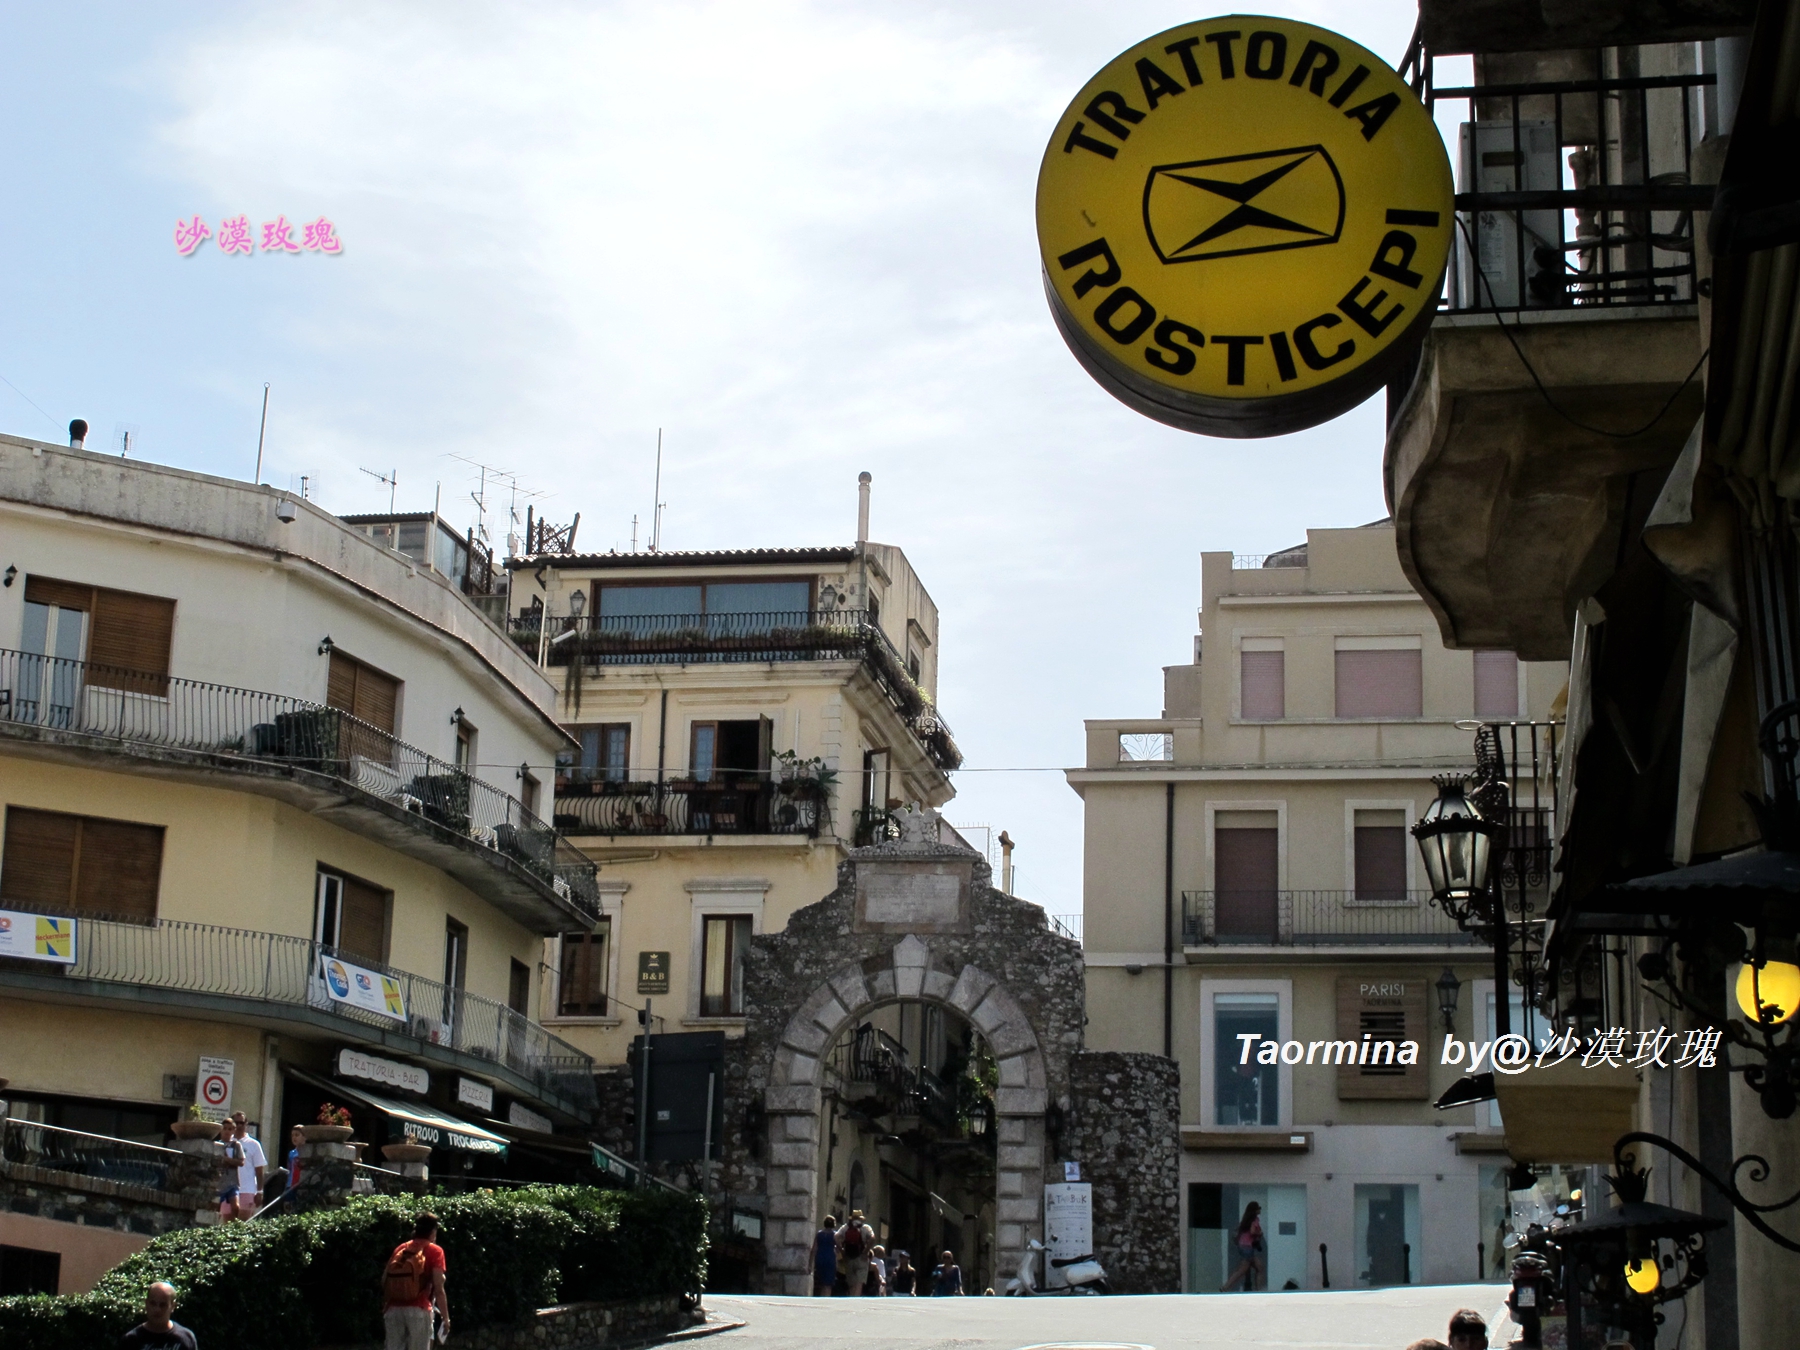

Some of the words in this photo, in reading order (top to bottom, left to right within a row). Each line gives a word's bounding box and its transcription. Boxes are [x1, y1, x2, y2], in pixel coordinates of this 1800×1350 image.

[1062, 30, 1401, 161] TRATTORIA
[1057, 208, 1440, 387] ROSTICEPI
[1360, 983, 1405, 996] PARISI
[349, 1057, 395, 1079] TRATTORIA
[402, 1072, 419, 1086] BAR
[404, 1122, 439, 1143] RITROVO
